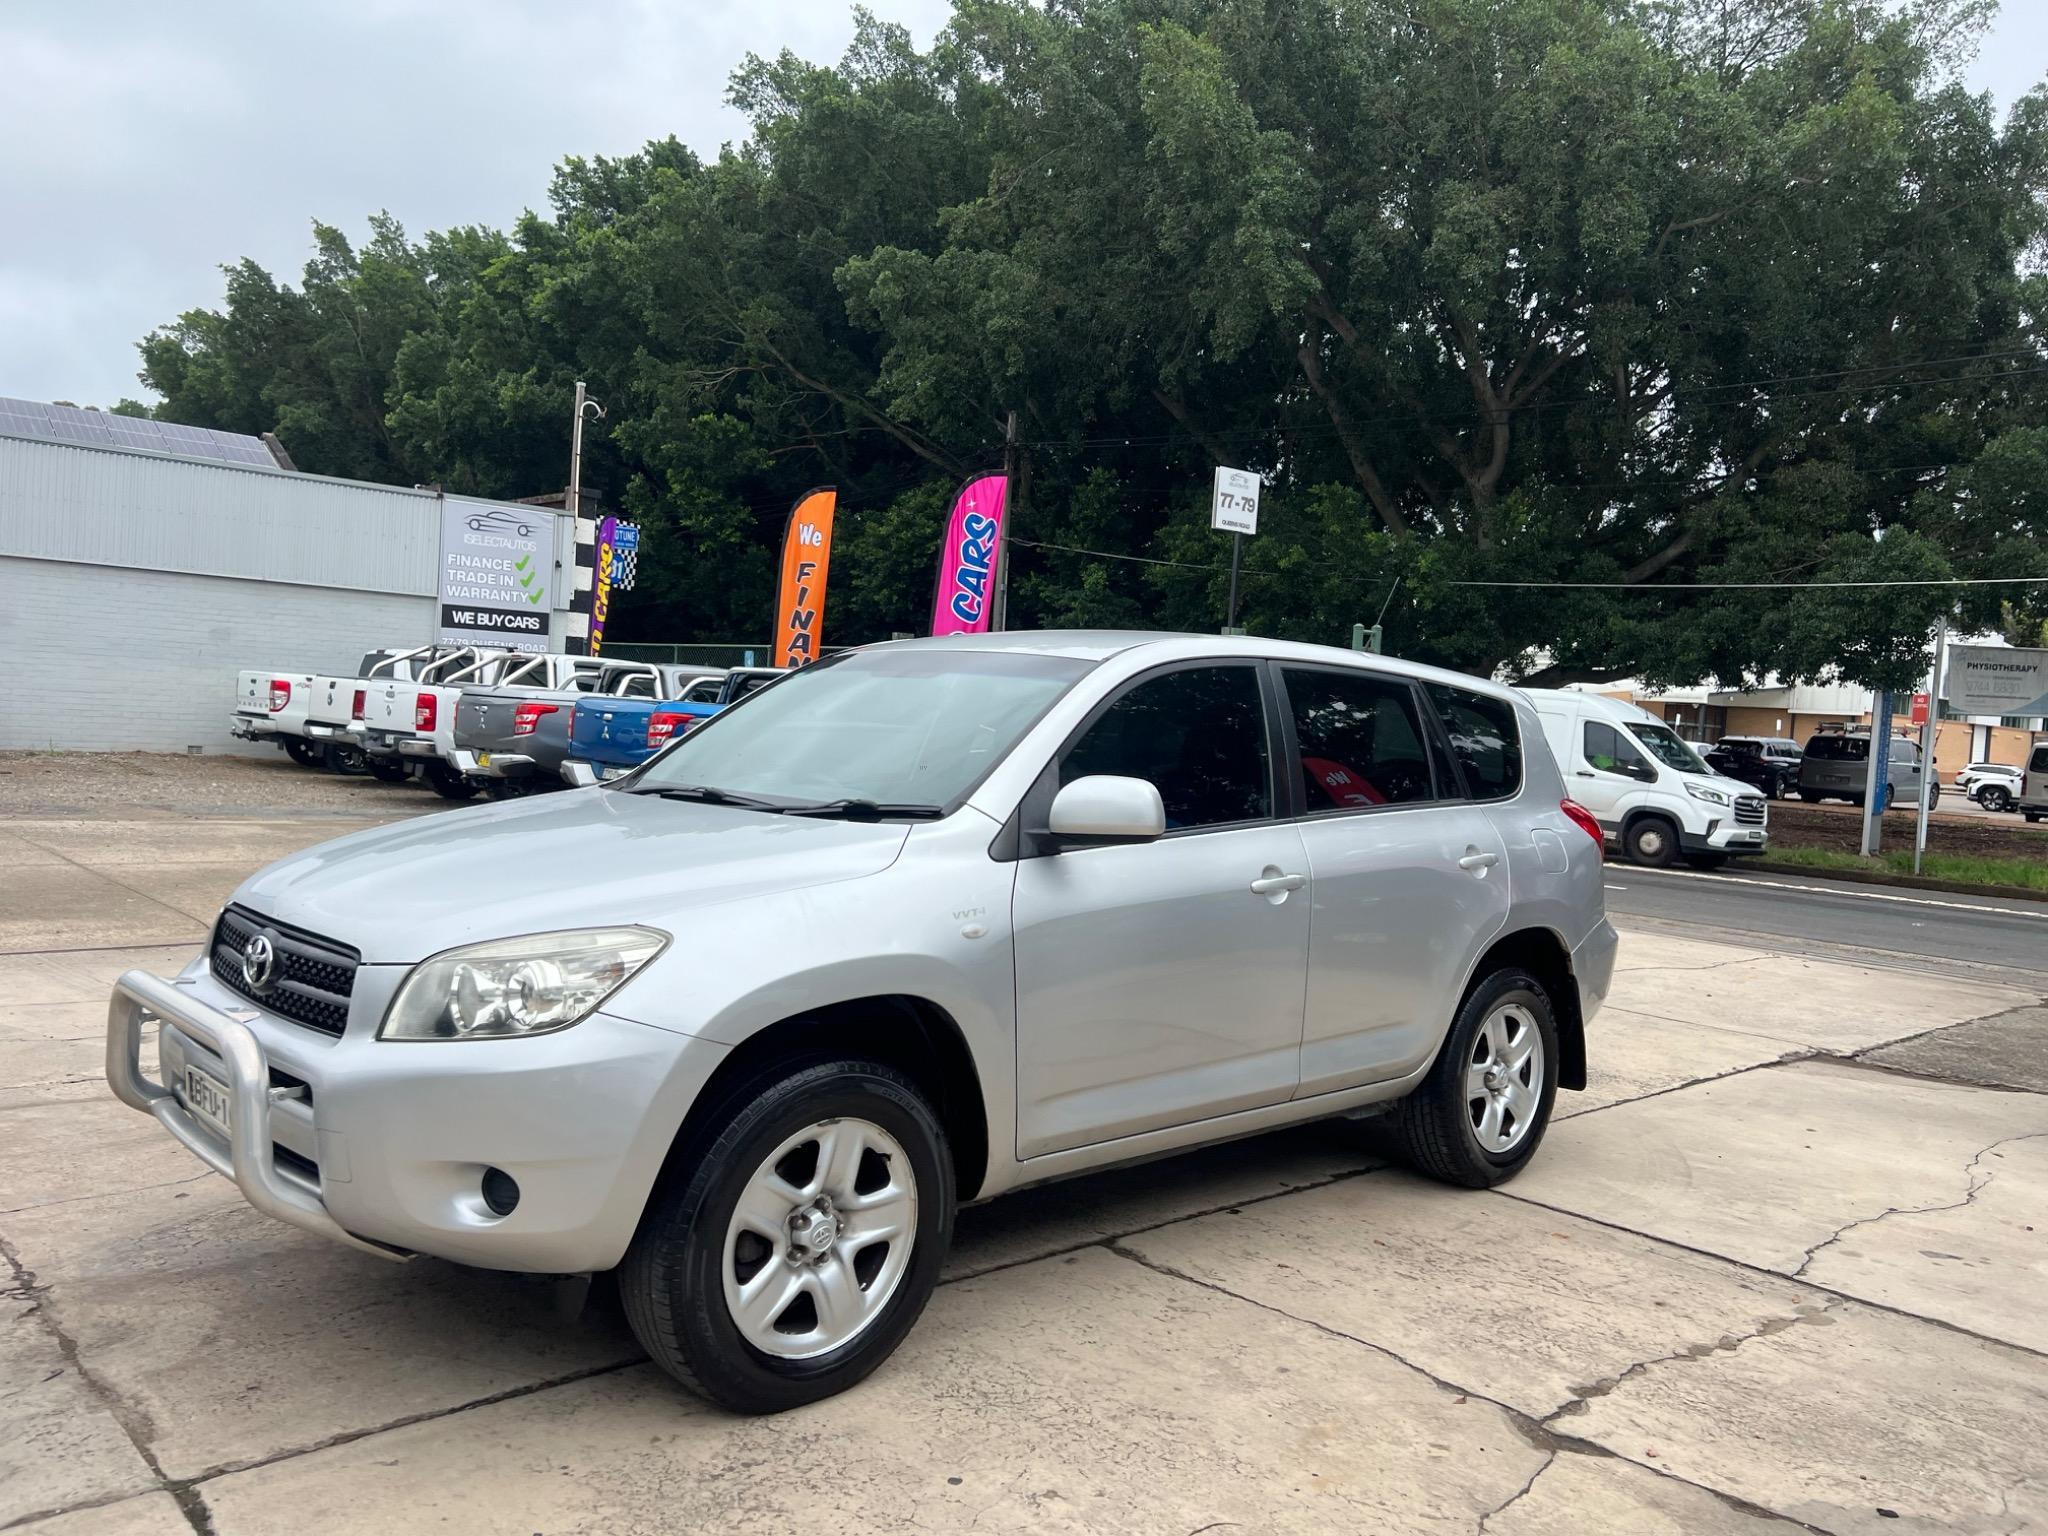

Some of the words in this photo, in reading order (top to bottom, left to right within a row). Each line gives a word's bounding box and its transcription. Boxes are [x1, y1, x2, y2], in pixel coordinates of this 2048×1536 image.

[800, 522, 823, 547] We
[447, 553, 512, 571] FINANCE
[951, 512, 997, 624] CARS
[447, 570, 497, 585] TRADE
[500, 575, 514, 587] IN
[447, 585, 529, 603] WARRANTY
[452, 610, 475, 625] WE
[477, 613, 504, 627] BUY
[504, 615, 540, 630] CARS
[517, 643, 547, 653] ROAD
[1967, 662, 2038, 673] PHYSIOTHERAPY
